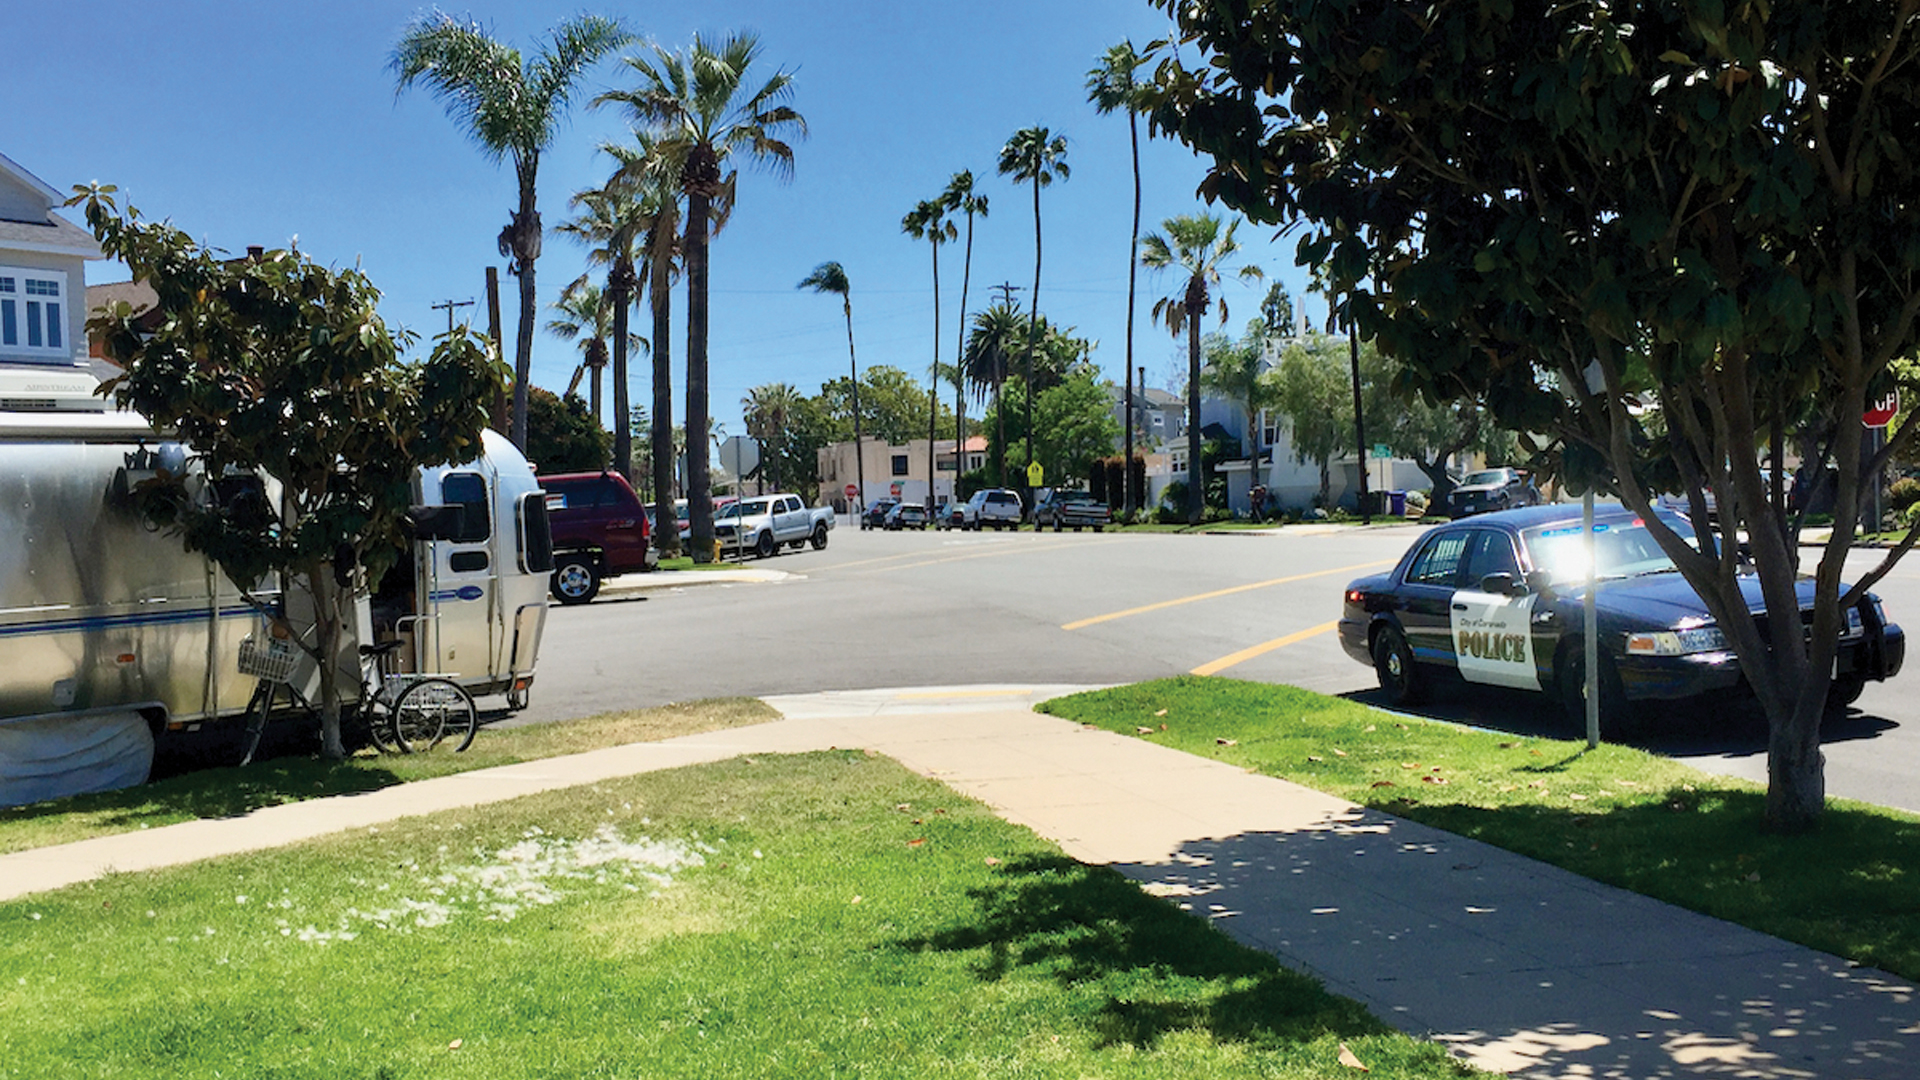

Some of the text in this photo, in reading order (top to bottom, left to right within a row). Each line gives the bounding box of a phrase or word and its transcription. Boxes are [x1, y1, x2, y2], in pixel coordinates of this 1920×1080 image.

[24, 384, 86, 392] AIRSTREAM
[1460, 618, 1471, 627] City
[1459, 631, 1525, 662] POLICE
